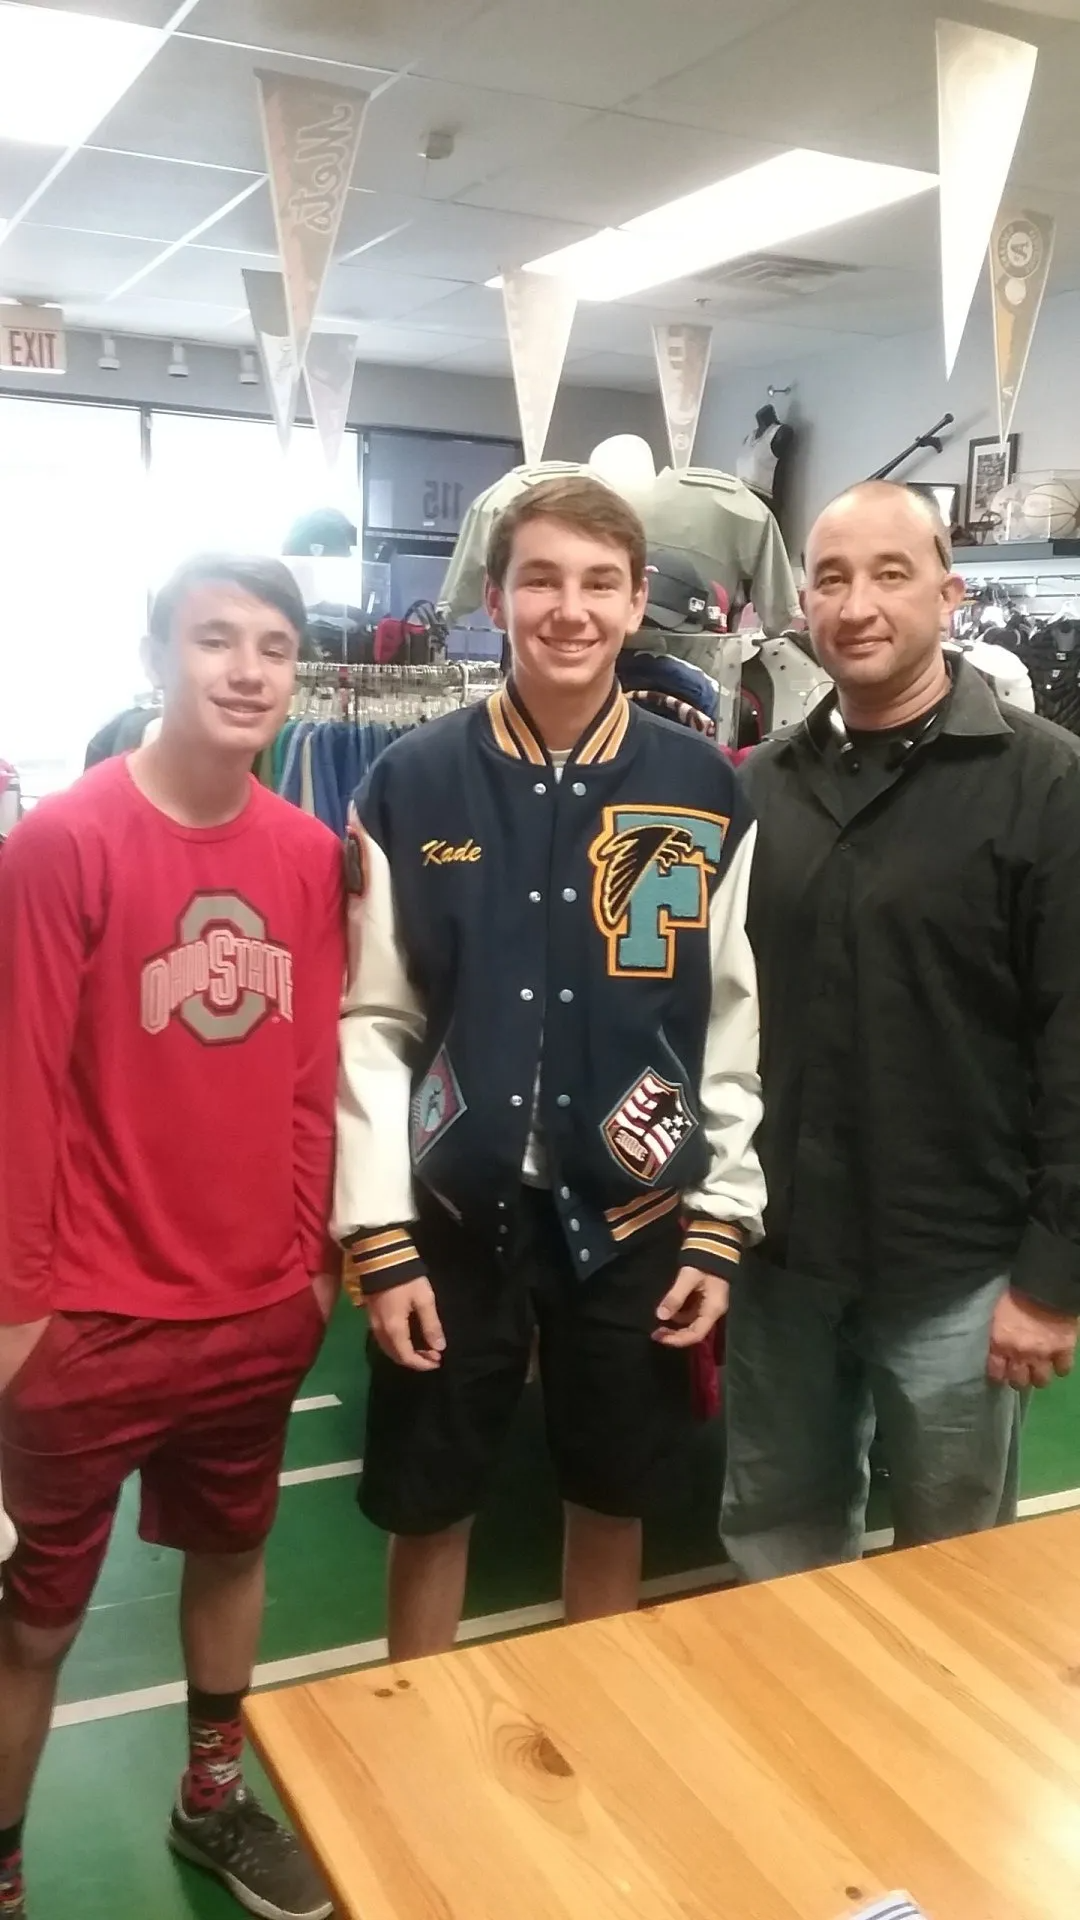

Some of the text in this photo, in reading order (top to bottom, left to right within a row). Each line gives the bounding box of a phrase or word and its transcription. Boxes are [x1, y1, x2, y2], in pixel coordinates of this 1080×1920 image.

[9, 330, 56, 369] EXIT
[420, 839, 482, 866] Kade
[600, 804, 730, 979] F
